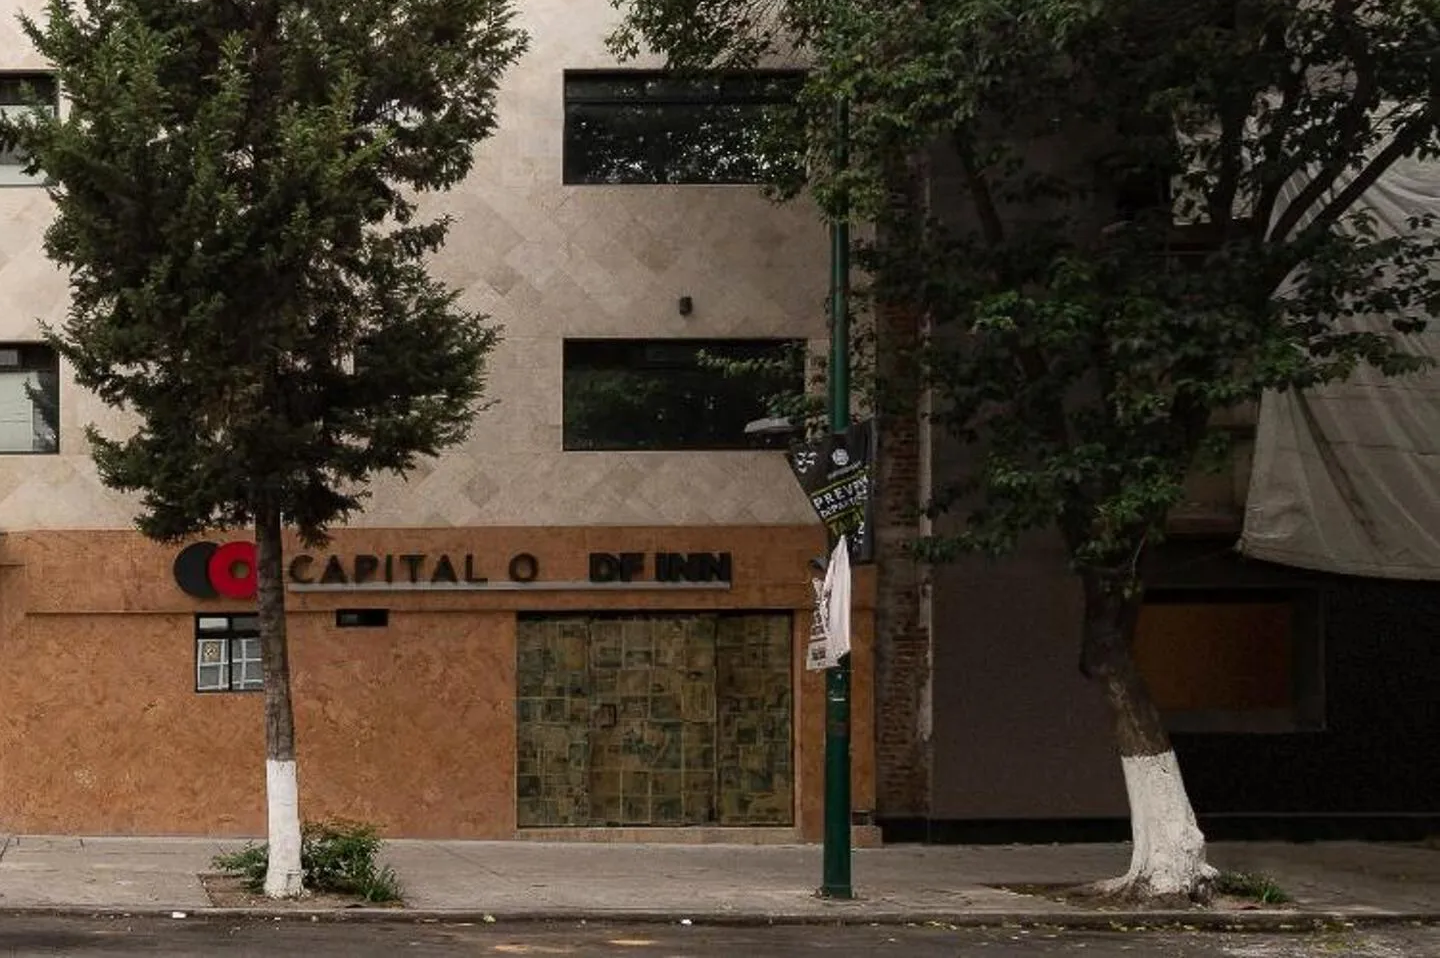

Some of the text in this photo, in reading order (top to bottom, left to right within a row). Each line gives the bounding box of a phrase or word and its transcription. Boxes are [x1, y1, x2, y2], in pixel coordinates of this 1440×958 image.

[288, 553, 489, 584] CAPITAL
[508, 552, 540, 583] O
[655, 551, 732, 582] INN
